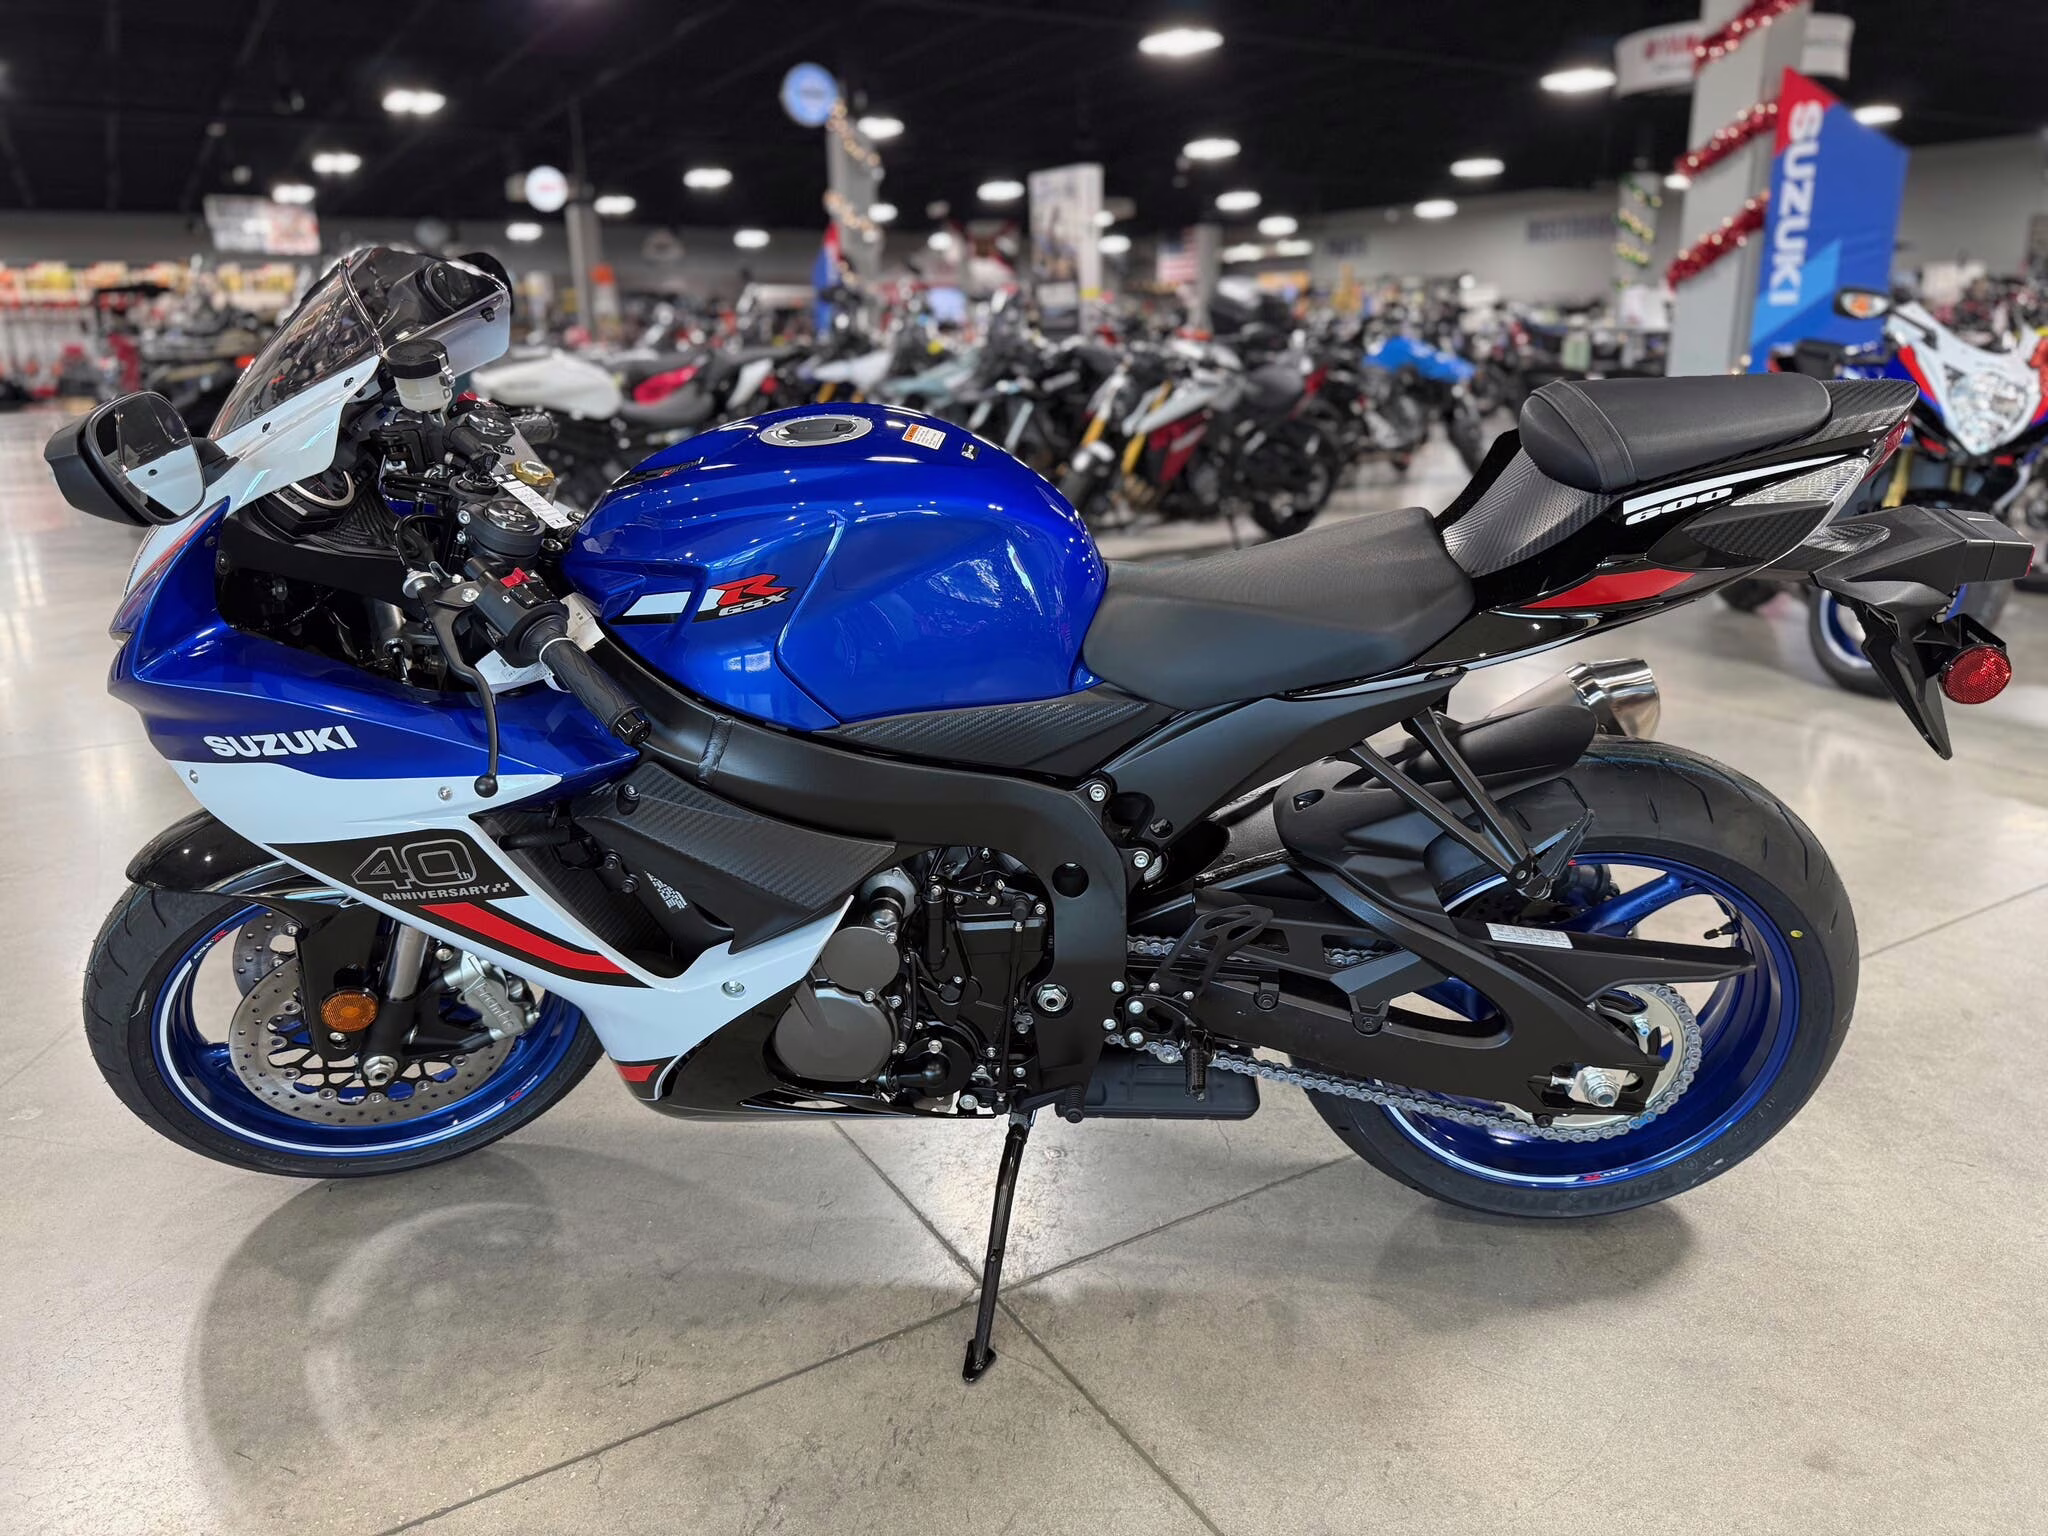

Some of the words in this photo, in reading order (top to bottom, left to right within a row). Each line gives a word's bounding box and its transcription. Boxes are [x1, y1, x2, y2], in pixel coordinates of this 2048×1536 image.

[1767, 99, 1824, 307] SUZUKI
[1625, 487, 1733, 526] 600
[709, 573, 790, 607] R
[718, 589, 790, 617] GSX
[203, 725, 358, 758] SUZUKI
[382, 884, 490, 901] ANNIVERSARY
